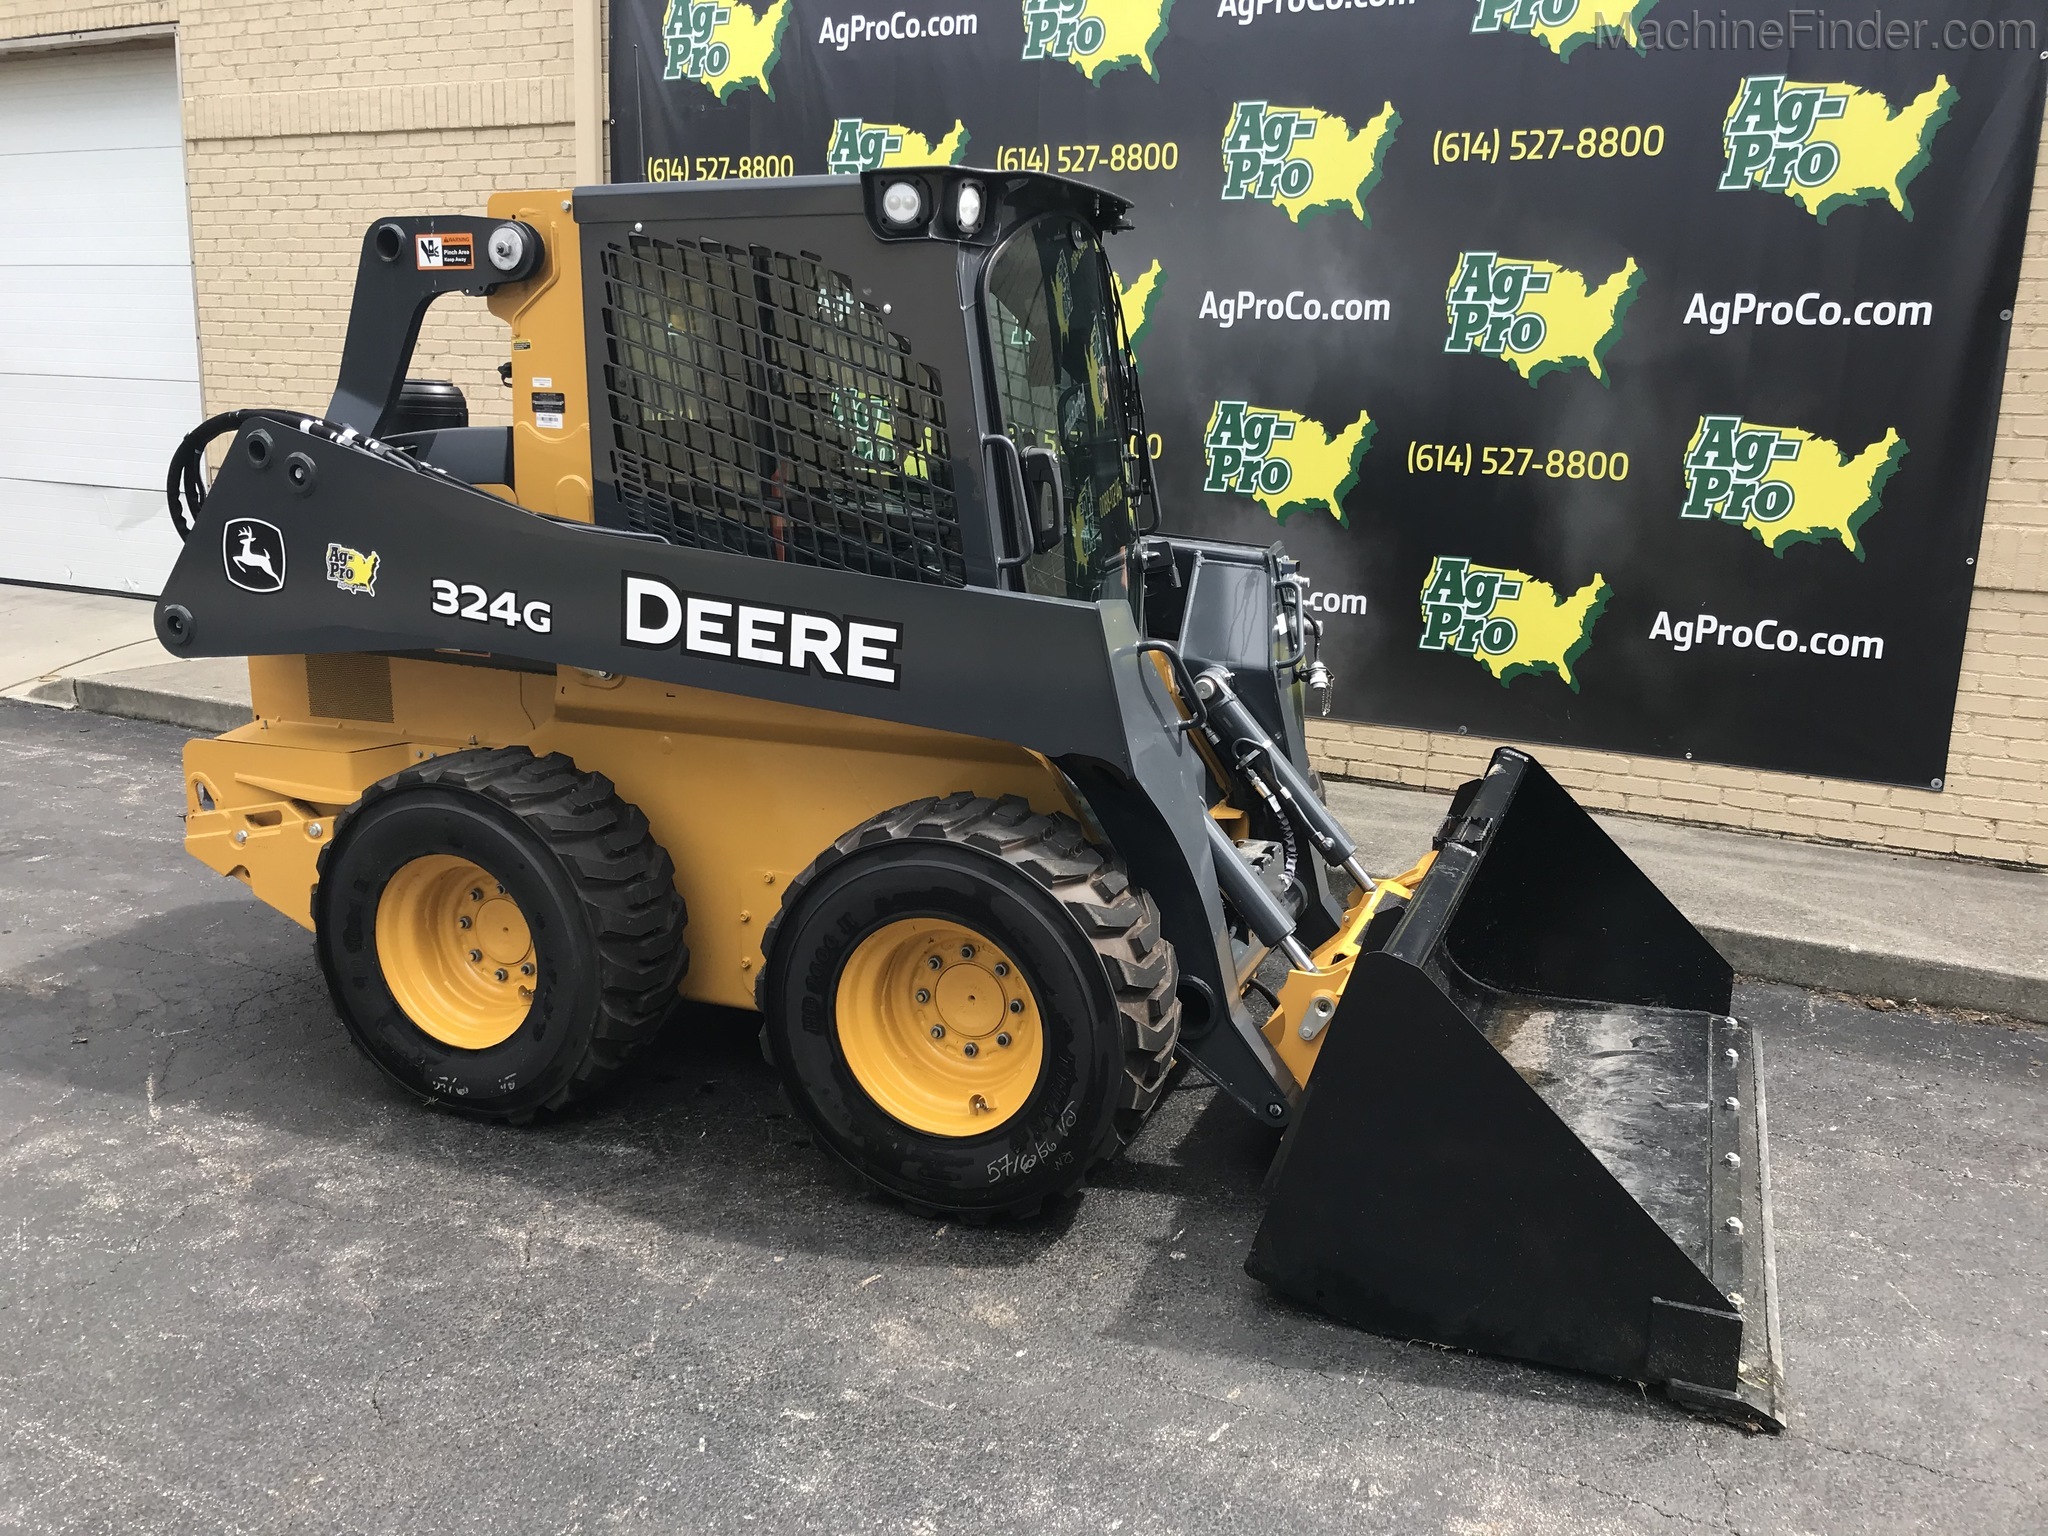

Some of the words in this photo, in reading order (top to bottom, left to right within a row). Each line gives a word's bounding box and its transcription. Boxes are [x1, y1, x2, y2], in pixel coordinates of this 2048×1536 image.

[819, 10, 978, 51] AgProCo.com
[1022, 10, 1105, 60] Pro
[664, 37, 730, 80] Pro
[1224, 101, 1317, 160] Ag-
[1725, 75, 1848, 145] Ag-
[647, 156, 690, 182] (614)
[696, 154, 794, 181] 527-8800
[996, 143, 1050, 173] (614)
[1057, 142, 1179, 173] 527-8800
[1433, 128, 1500, 165] (614)
[1509, 124, 1665, 161] 527-8800
[1720, 133, 1840, 189] Pro
[1221, 151, 1314, 201] Pro
[1448, 251, 1551, 314] Ag-
[1198, 290, 1391, 329] AgProCo.com
[1444, 301, 1545, 352] Pro
[1682, 292, 1933, 335] AgProCo.com
[1206, 401, 1296, 457] Ag-
[1687, 415, 1802, 480] Ag-
[1203, 447, 1291, 494] Pro
[1407, 441, 1472, 476] (614)
[1481, 446, 1629, 481] 527-8800
[1681, 467, 1794, 522] Pro
[329, 546, 354, 567] Ag-
[329, 562, 354, 580] Pro
[431, 579, 552, 633] 324G
[1422, 556, 1522, 616] Ag-
[626, 576, 898, 684] DEERE
[1418, 604, 1517, 655] Pro
[1648, 611, 1884, 660] AgProCo.com
